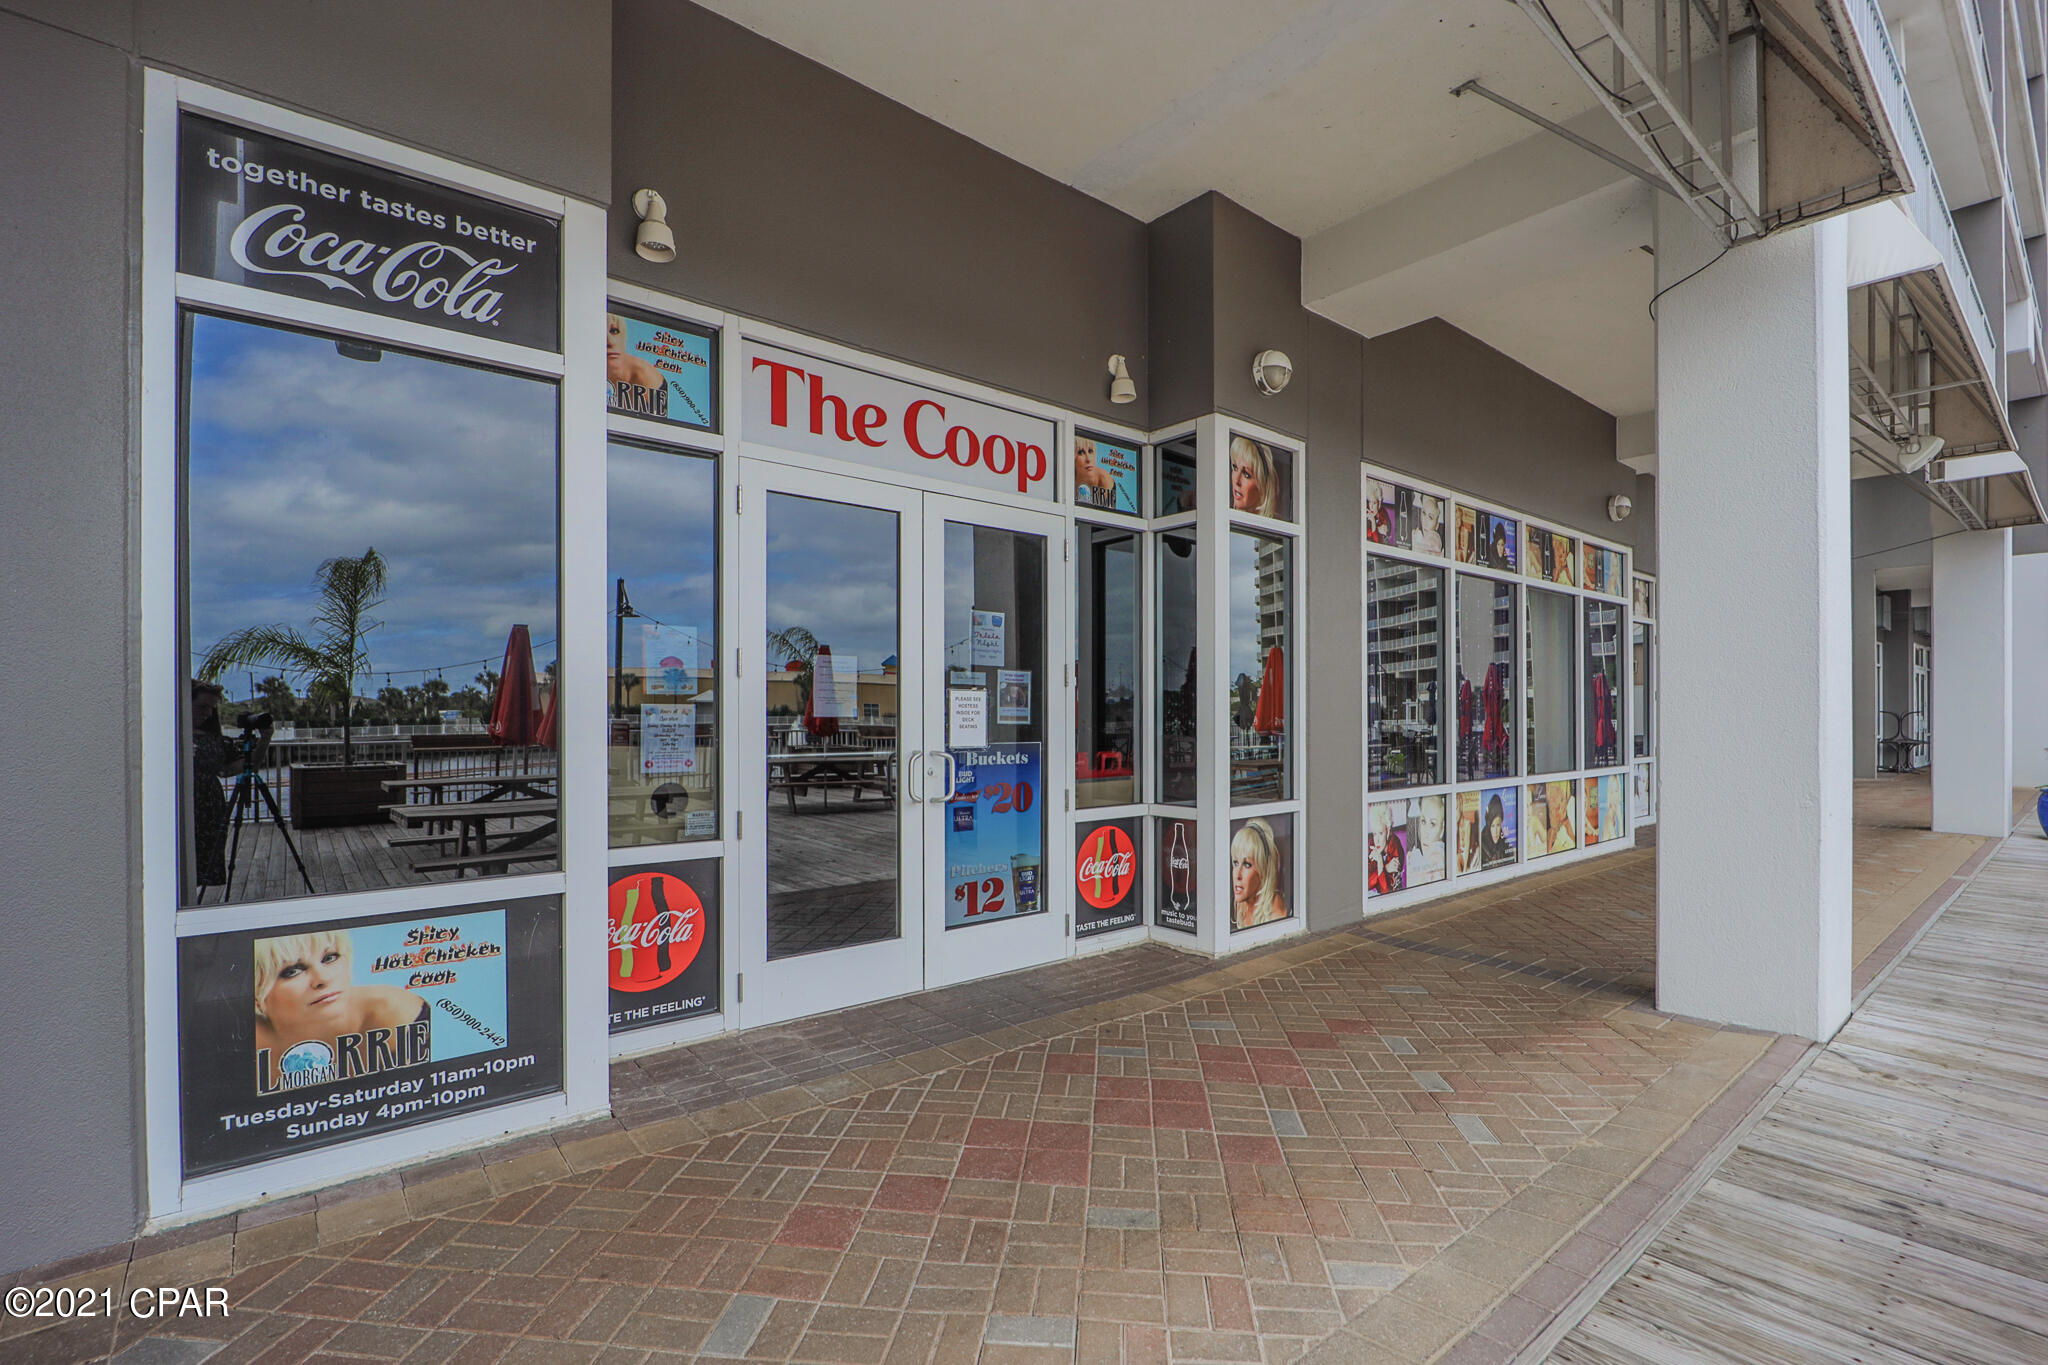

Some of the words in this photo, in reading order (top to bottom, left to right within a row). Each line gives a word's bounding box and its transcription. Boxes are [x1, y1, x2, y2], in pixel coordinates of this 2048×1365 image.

[207, 147, 350, 203] together
[360, 190, 446, 229] tastes
[455, 215, 537, 254] better
[230, 203, 519, 326] Coca-Cola
[636, 340, 660, 354] Hot
[661, 345, 708, 368] Chicken
[654, 331, 684, 348] Spicy
[752, 356, 888, 448] The
[903, 399, 1047, 493] Coop
[966, 751, 1029, 766] Buckets
[956, 776, 975, 784] LIGHT
[984, 781, 1033, 813] $20
[951, 863, 1009, 878] Pitchers
[1079, 851, 1132, 881] Coca-Cola
[954, 877, 1005, 917] $12
[405, 925, 460, 947] Spicy
[1076, 921, 1096, 932] TASTE
[1097, 918, 1109, 928] THE
[1110, 914, 1135, 926] FEELING
[372, 952, 413, 973] Hot
[423, 942, 502, 965] Chicken
[405, 969, 457, 990] Coop
[436, 997, 506, 1048] (850)900-2442
[624, 1006, 650, 1021] THE
[652, 996, 703, 1016] FEELING
[281, 1062, 337, 1088] MORGAN
[220, 1077, 423, 1131] Tuesday-Saturday
[430, 1052, 536, 1086] 11am-10pm
[286, 1105, 369, 1139] Sunday
[376, 1084, 486, 1120] 4pm-10pm
